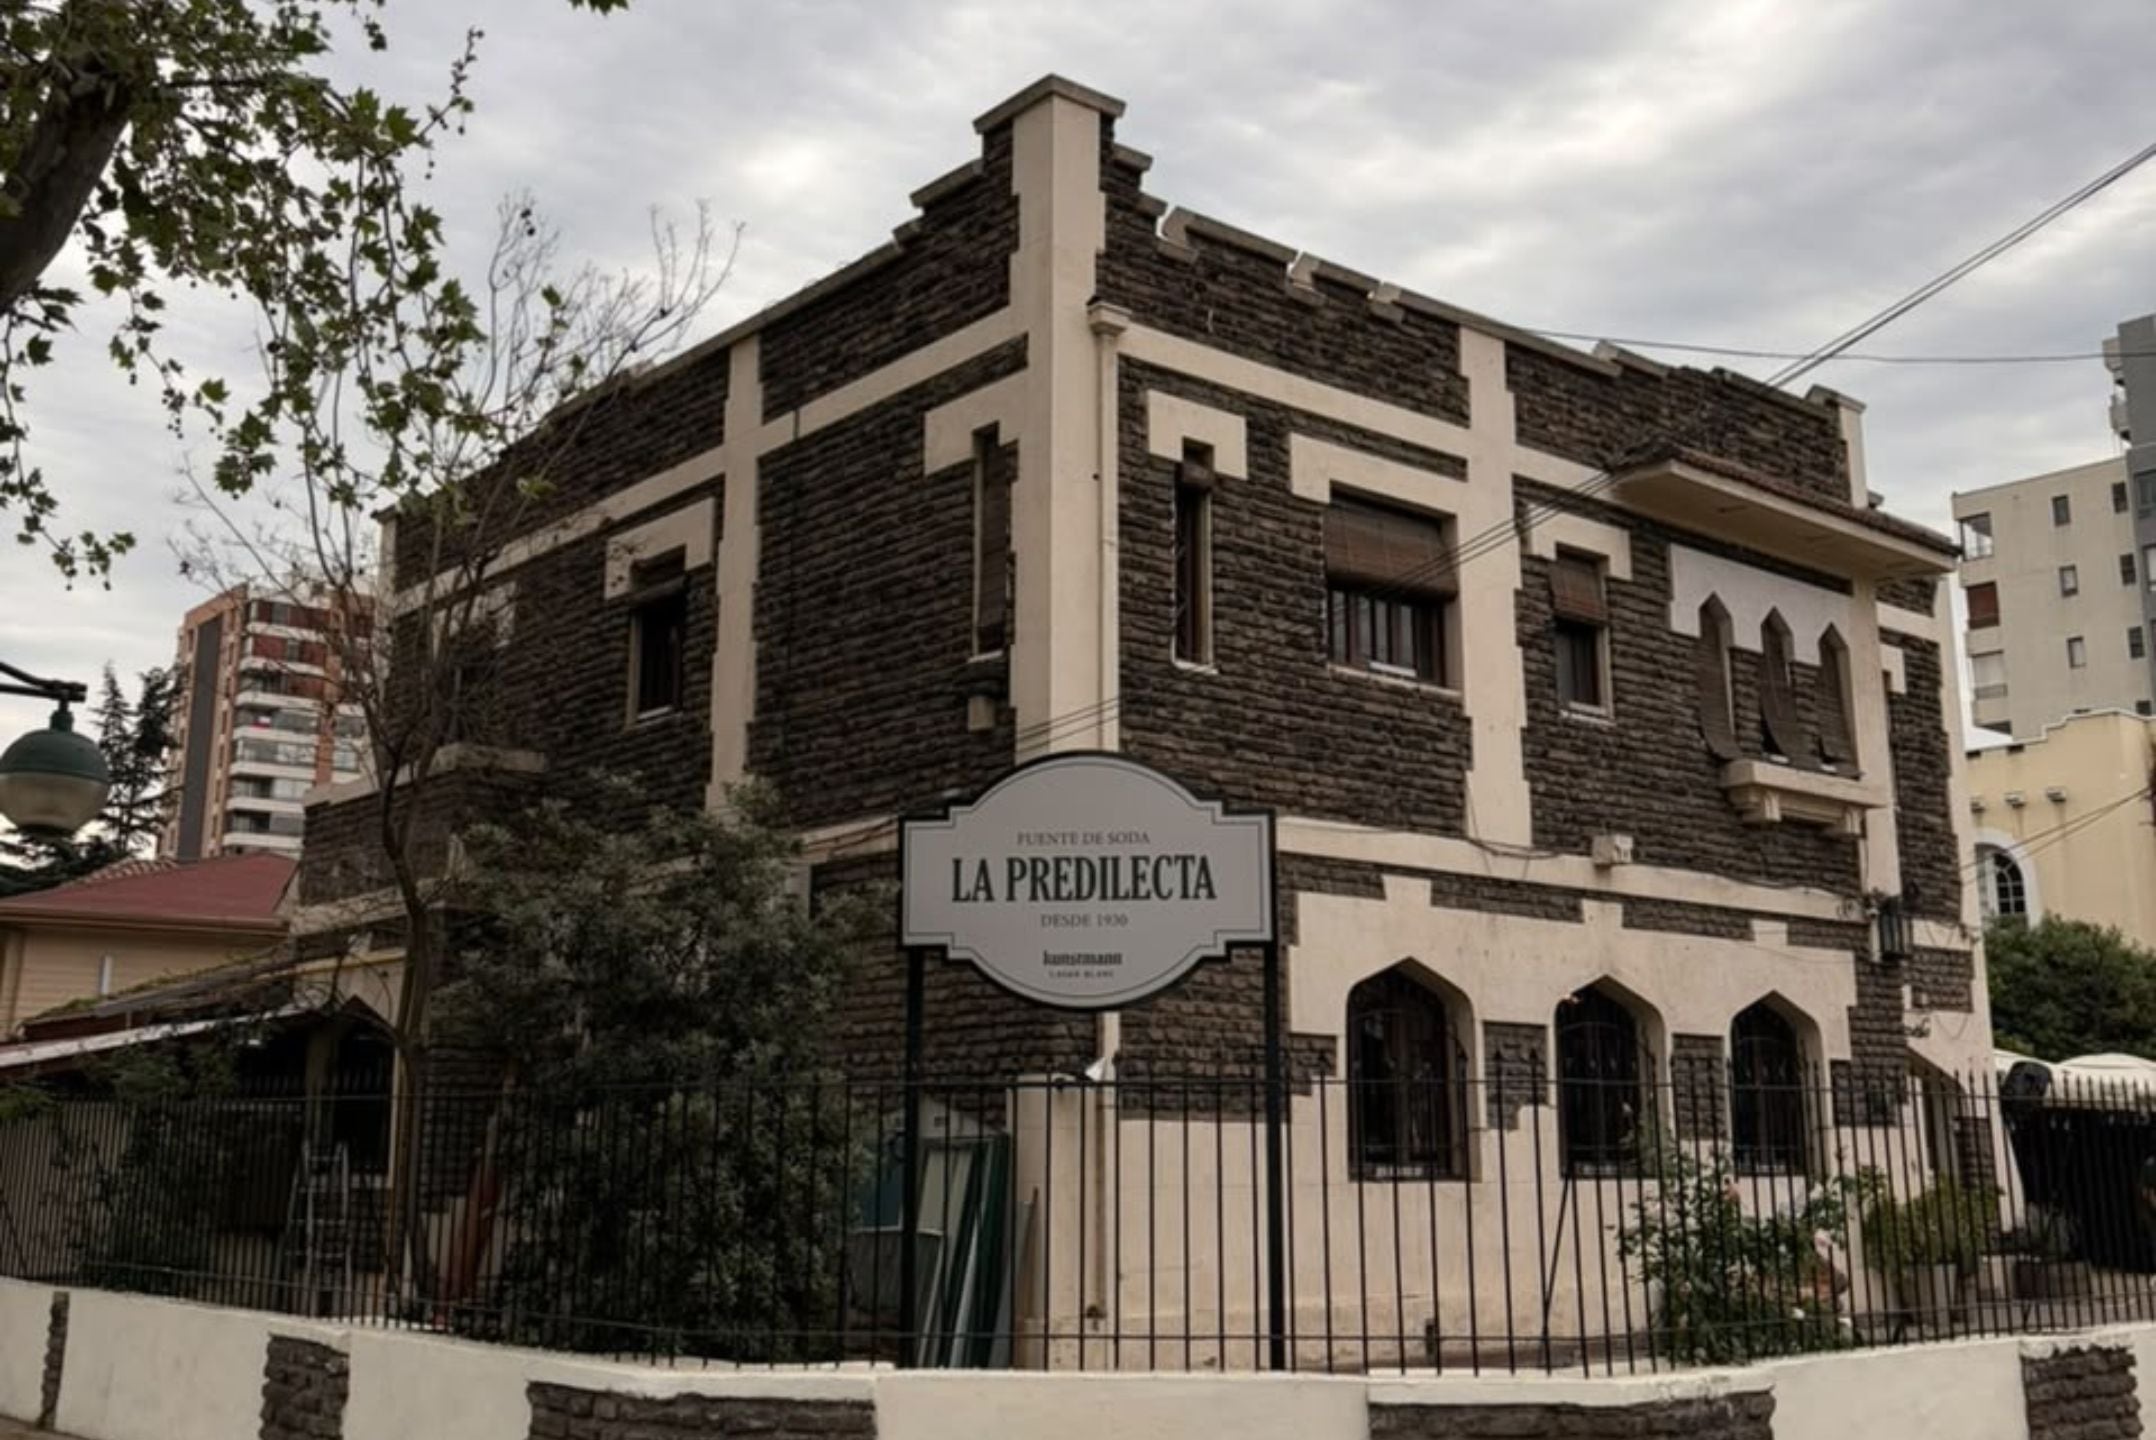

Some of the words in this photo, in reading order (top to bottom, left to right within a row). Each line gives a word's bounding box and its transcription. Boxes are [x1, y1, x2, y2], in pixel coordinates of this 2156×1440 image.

[1017, 831, 1077, 846] FUENTE
[1082, 831, 1103, 845] DE
[1107, 830, 1150, 844] SODA
[952, 858, 995, 902] LA
[1006, 855, 1216, 902] PREDILECTA
[1041, 914, 1090, 928] DESDE
